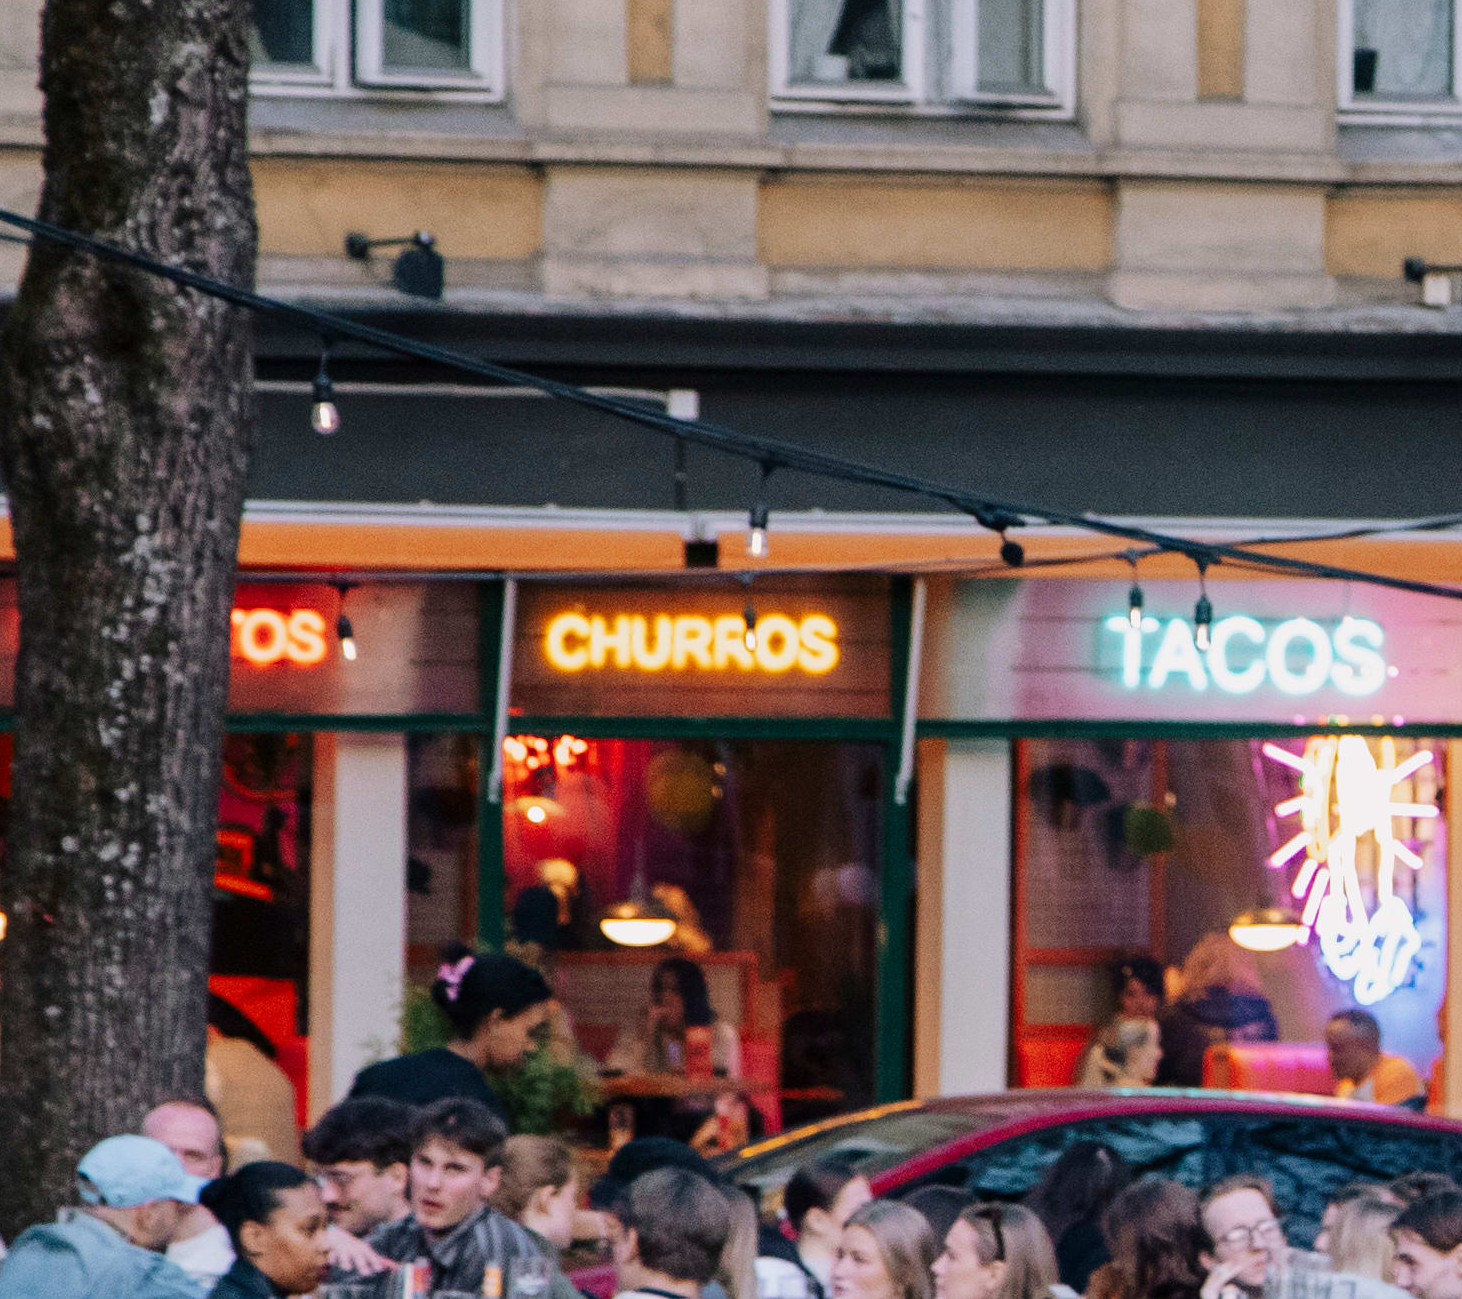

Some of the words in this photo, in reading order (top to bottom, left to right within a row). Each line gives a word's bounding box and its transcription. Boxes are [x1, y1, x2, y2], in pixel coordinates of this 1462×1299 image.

[231, 607, 328, 665] OS
[545, 611, 840, 674] CHURROS
[1104, 614, 1388, 696] TACOS
